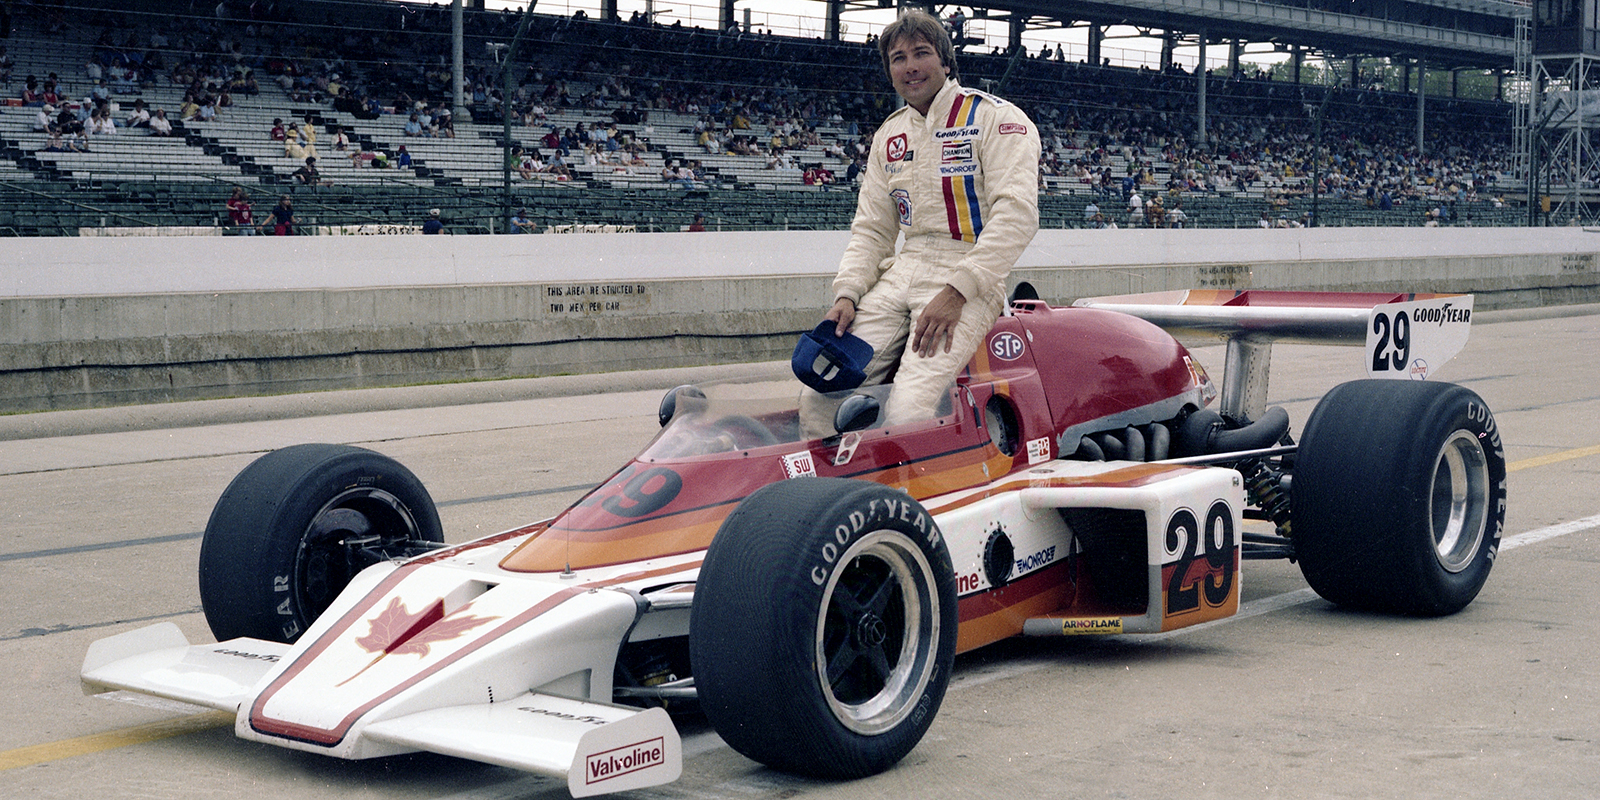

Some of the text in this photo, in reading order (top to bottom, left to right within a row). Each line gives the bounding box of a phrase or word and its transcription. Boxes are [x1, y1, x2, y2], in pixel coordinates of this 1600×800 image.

[943, 148, 971, 157] CHAMPION
[943, 165, 974, 174] MONROE
[547, 286, 563, 296] THIS
[566, 286, 585, 296] AREA
[637, 284, 646, 294] TO
[550, 303, 564, 313] TWO
[589, 302, 601, 312] PER
[605, 302, 620, 311] CAR
[994, 335, 1022, 357] STP
[1372, 310, 1411, 371] 29
[793, 458, 811, 474] SW
[1019, 547, 1054, 572] MONROE
[1163, 498, 1236, 618] 29
[1064, 620, 1121, 628] ARNOFLAME
[590, 747, 661, 778] Valvoline
